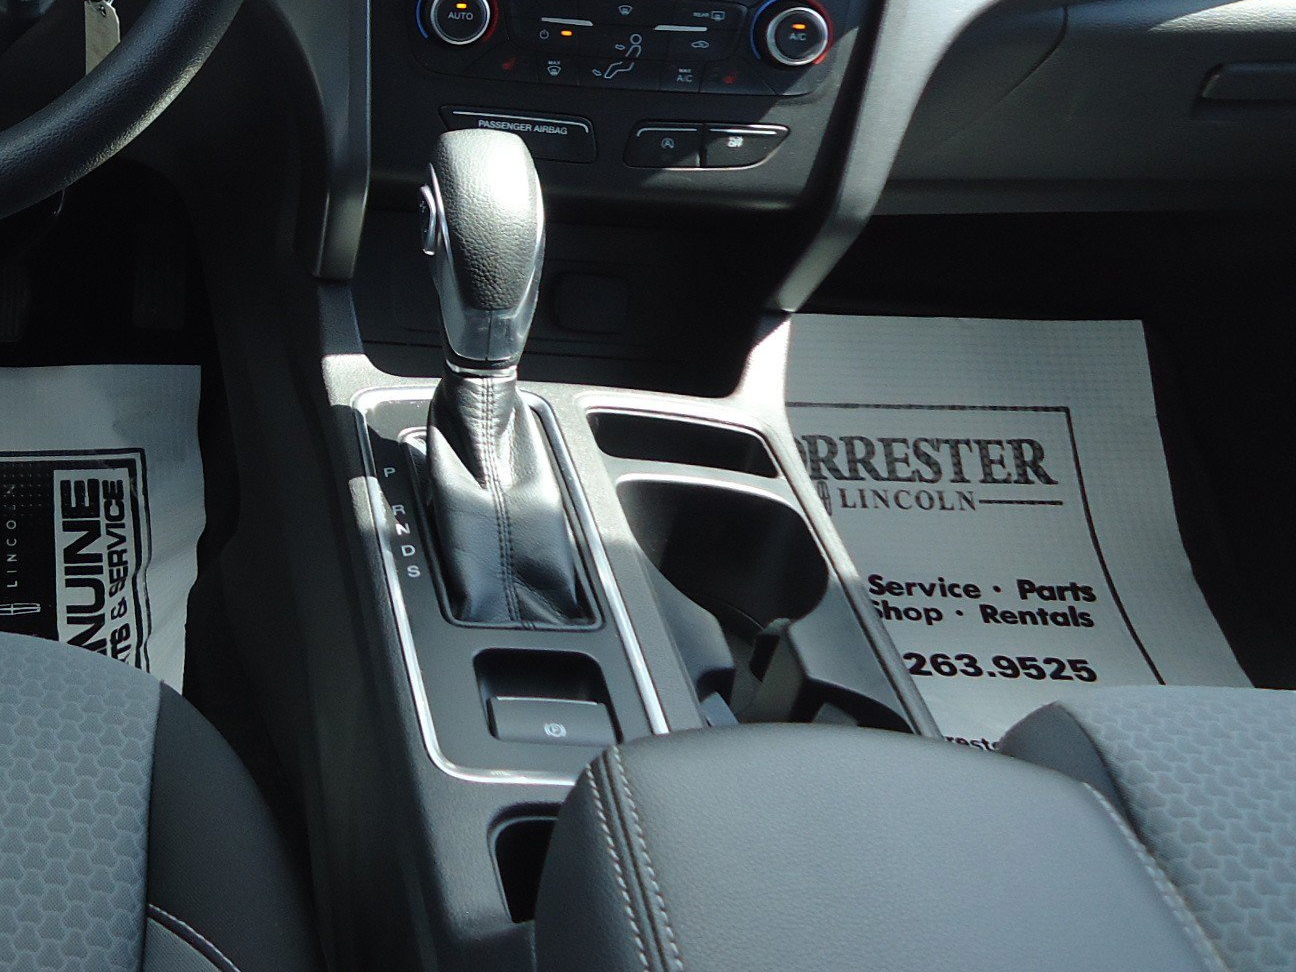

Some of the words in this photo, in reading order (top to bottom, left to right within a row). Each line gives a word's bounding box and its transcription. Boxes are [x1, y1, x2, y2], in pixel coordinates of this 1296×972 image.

[448, 11, 474, 21] AUTO
[789, 33, 807, 41] A/C
[676, 74, 693, 83] A/C
[478, 119, 532, 132] PASSENGER
[534, 124, 568, 134] AIRBAG
[795, 434, 1058, 485] RRESTER
[384, 467, 396, 478] P
[838, 487, 976, 512] LINCOLN
[392, 504, 406, 515] R
[102, 479, 129, 598] SERVICE
[396, 523, 410, 535] N
[401, 545, 416, 557] D
[60, 478, 108, 656] NUINE
[408, 565, 421, 578] S
[868, 574, 982, 599] Service
[1016, 579, 1097, 603] Parts
[111, 597, 128, 620] &
[979, 604, 1095, 628] Rentals
[110, 623, 131, 664] TS
[903, 652, 1098, 683] 263.9525
